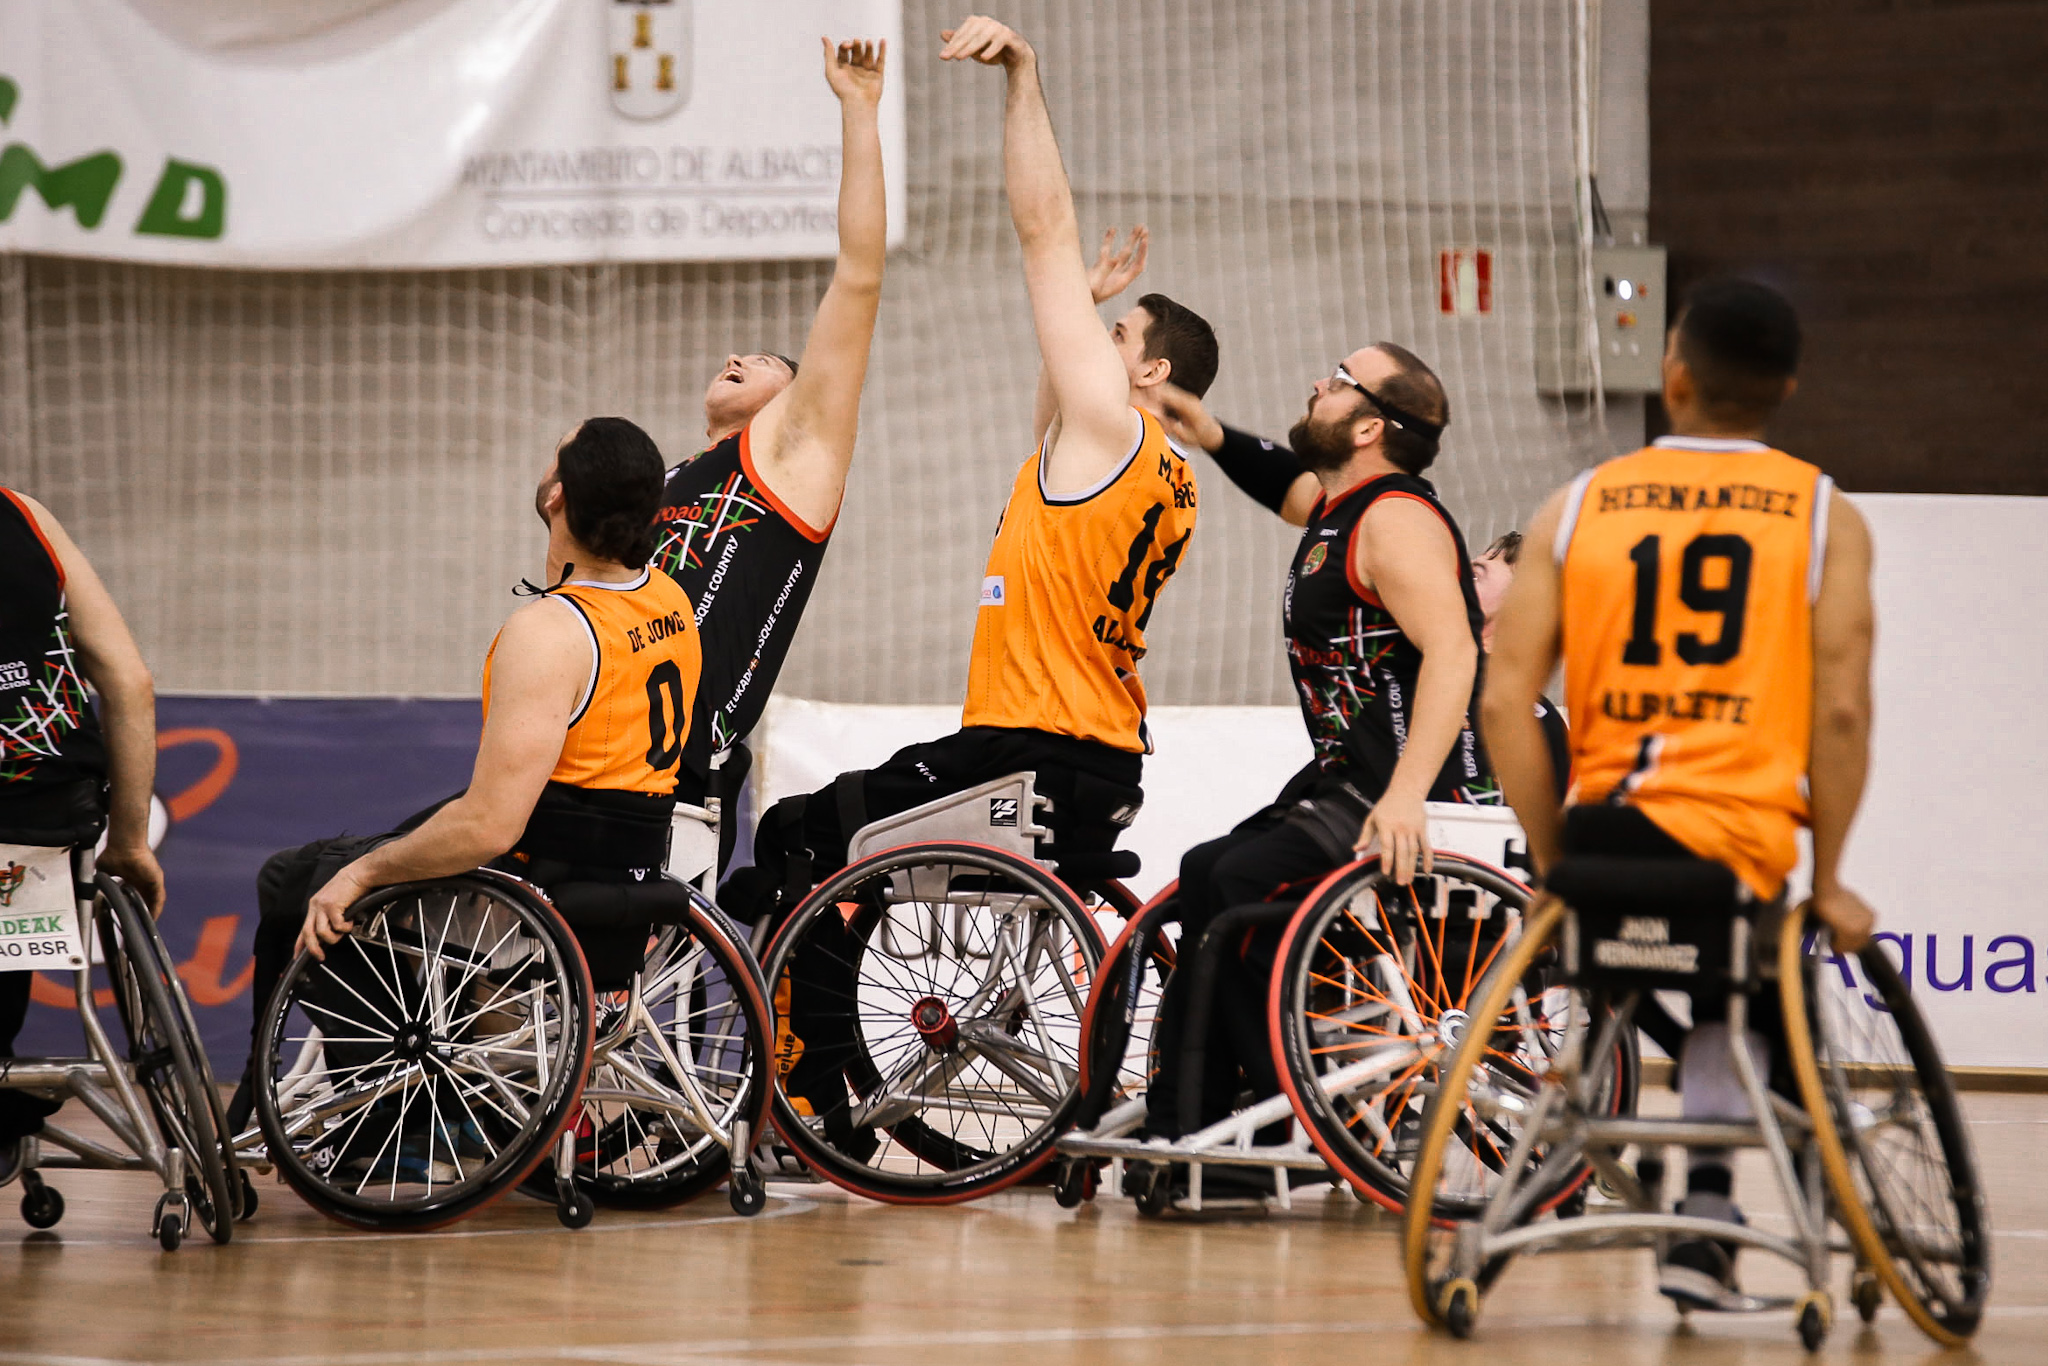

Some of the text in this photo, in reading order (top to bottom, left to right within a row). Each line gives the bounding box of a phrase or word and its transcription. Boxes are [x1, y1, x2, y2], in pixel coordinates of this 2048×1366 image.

[670, 146, 705, 182] DE
[722, 145, 843, 183] ALBACE
[1599, 483, 1799, 519] HERNANDEZ
[709, 534, 739, 591] COUNTRY
[773, 558, 803, 614] COUNTRY
[1107, 502, 1192, 632] 14
[1621, 533, 1754, 667] 19
[626, 610, 686, 654] DE JONG
[645, 659, 686, 772] 0
[28, 940, 69, 956] BSR
[1798, 929, 2048, 1014] Agua
